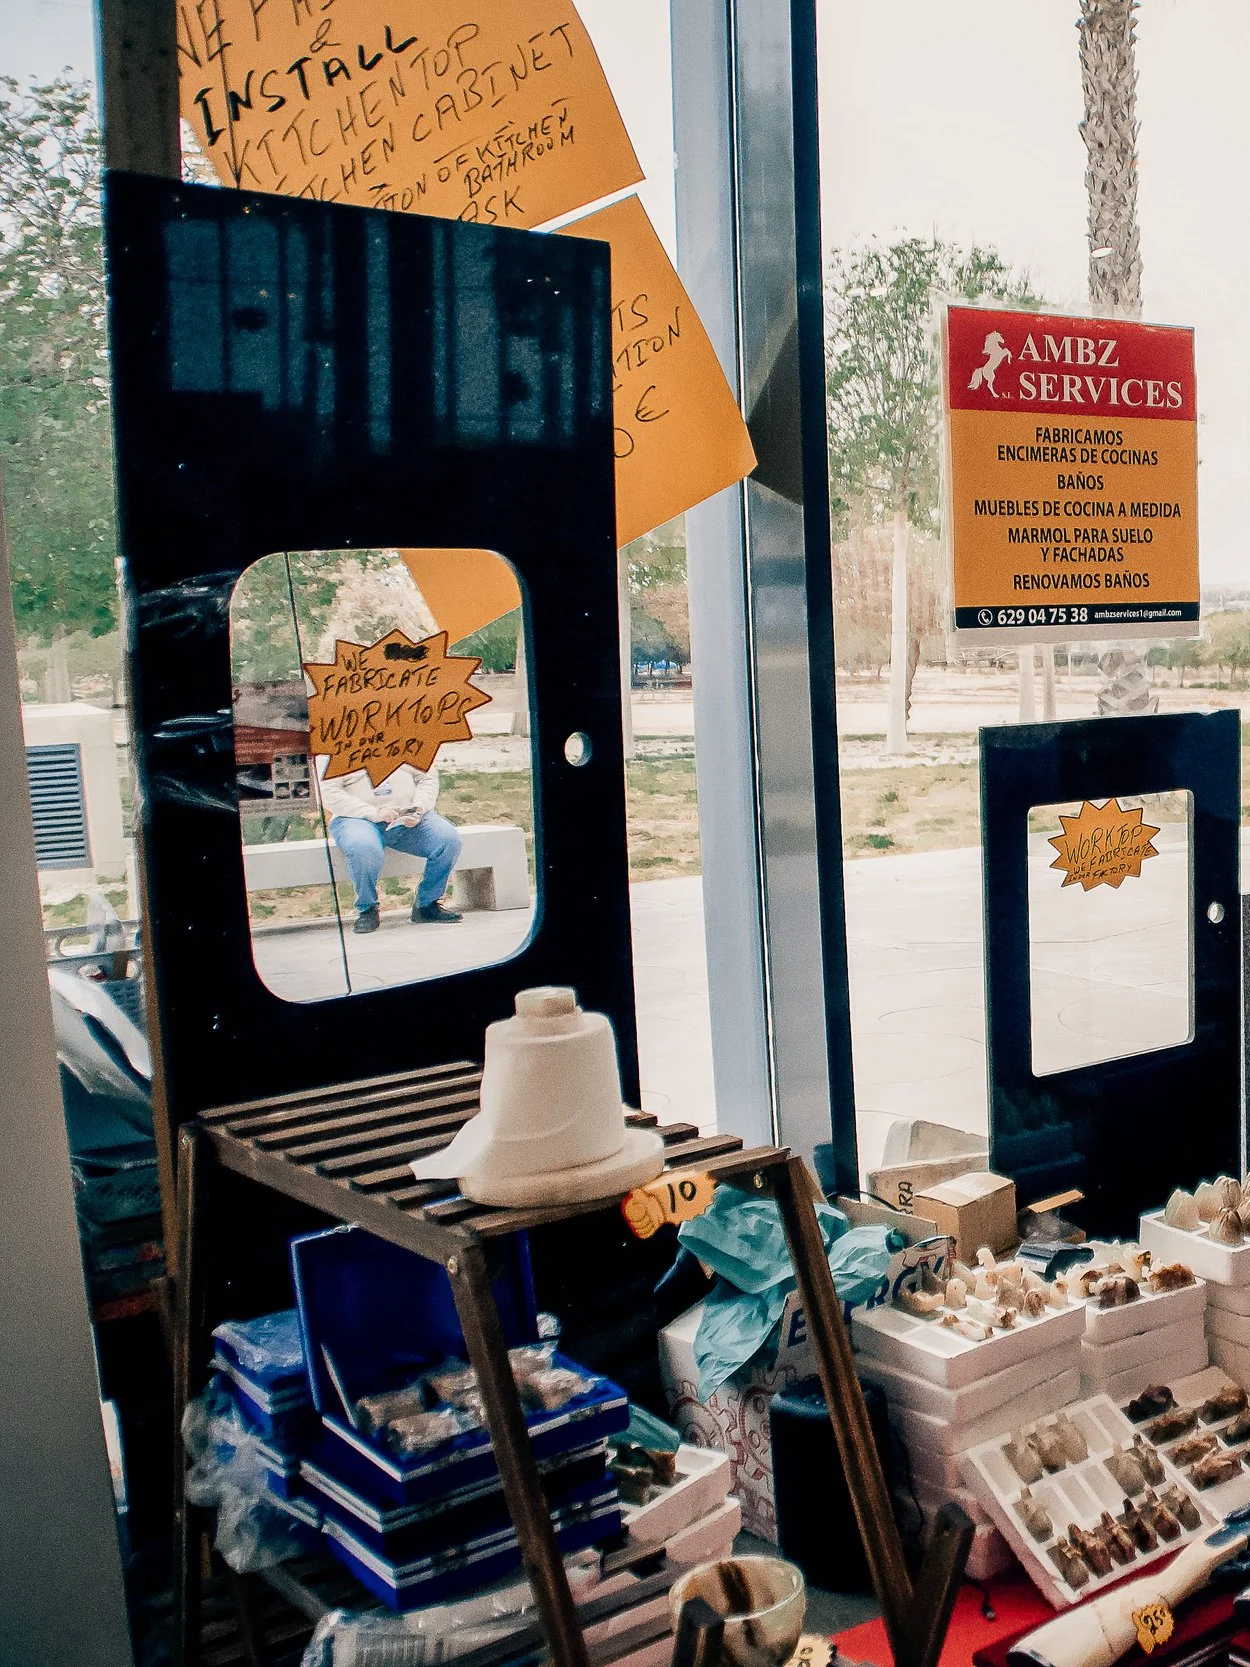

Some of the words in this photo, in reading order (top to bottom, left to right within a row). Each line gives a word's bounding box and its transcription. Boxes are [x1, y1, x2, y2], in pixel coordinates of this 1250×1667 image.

[193, 24, 419, 147] INSTALL
[411, 22, 573, 143] CABINET
[464, 125, 575, 198] BATHROOM
[613, 305, 680, 379] TION
[1018, 333, 1120, 367] AMBZ
[1019, 373, 1183, 408] SERVICES
[1035, 426, 1124, 446] FABRICAMOS
[997, 445, 1077, 463] ENCIMERAS
[1079, 448, 1098, 464] DE
[1100, 449, 1159, 466] COCINAS
[1057, 470, 1105, 491] BAÑOS
[974, 499, 1039, 517] MUEBLES
[1042, 500, 1061, 517] DE
[1063, 500, 1115, 518] COCINA
[1117, 501, 1128, 518] A
[1130, 501, 1182, 518] MEDIDA
[1008, 527, 1071, 544] MARMOL
[1073, 527, 1110, 544] PARA
[1112, 527, 1154, 544] SUELO
[1040, 547, 1049, 563] Y
[1052, 546, 1125, 563] FACHADAS
[1013, 572, 1101, 590] RENOVAMOS
[1104, 569, 1151, 589] BAÑOS
[997, 608, 1025, 625] 629
[1028, 608, 1046, 624] 04
[1049, 607, 1068, 624] 75
[1070, 607, 1089, 623] 38
[1094, 608, 1182, 619] ambzservices1@gmail.com
[341, 650, 369, 673] WE
[322, 663, 442, 702] FABRICATE
[358, 731, 386, 746] OUR
[348, 738, 425, 768] FACTORY
[1073, 862, 1086, 875] WE
[1090, 843, 1152, 872] FABRICATE
[1092, 863, 1133, 882] FACTORY
[666, 1180, 697, 1213] 10
